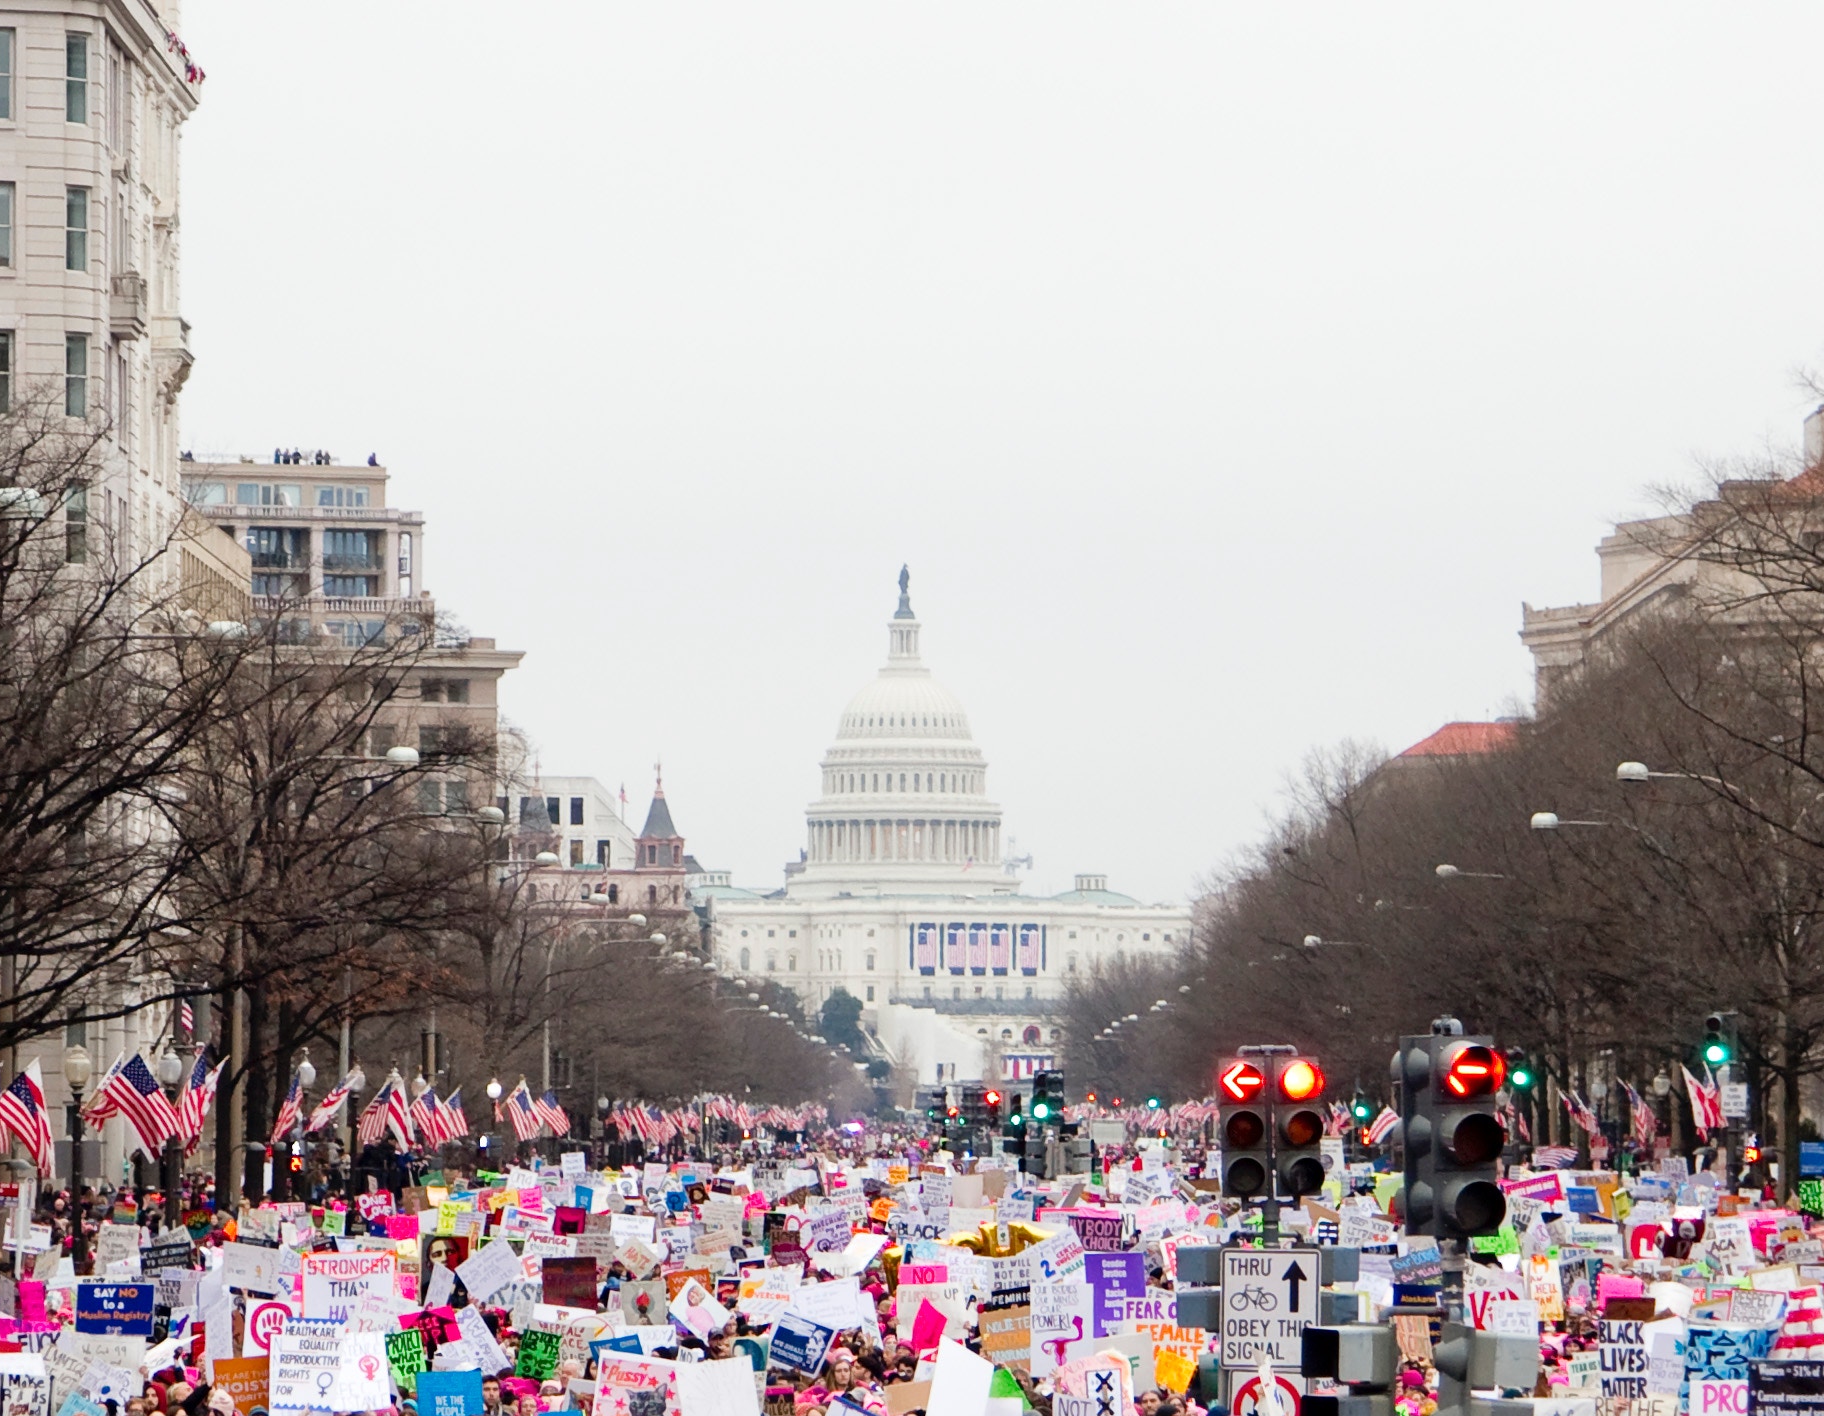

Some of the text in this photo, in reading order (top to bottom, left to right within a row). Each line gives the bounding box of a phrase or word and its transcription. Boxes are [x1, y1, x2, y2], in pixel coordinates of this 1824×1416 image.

[307, 1259, 389, 1276] STRONGER
[1229, 1257, 1271, 1277] THRU
[93, 1287, 138, 1300] SAY NO
[103, 1300, 125, 1310] to a
[1226, 1319, 1313, 1338] OBEY THIS
[1599, 1320, 1644, 1344] BLACK
[1227, 1340, 1285, 1360] SIGNAL
[1600, 1349, 1643, 1372] LIVES
[1600, 1374, 1647, 1398] MATTER
[435, 1407, 465, 1416] PEOPLE
